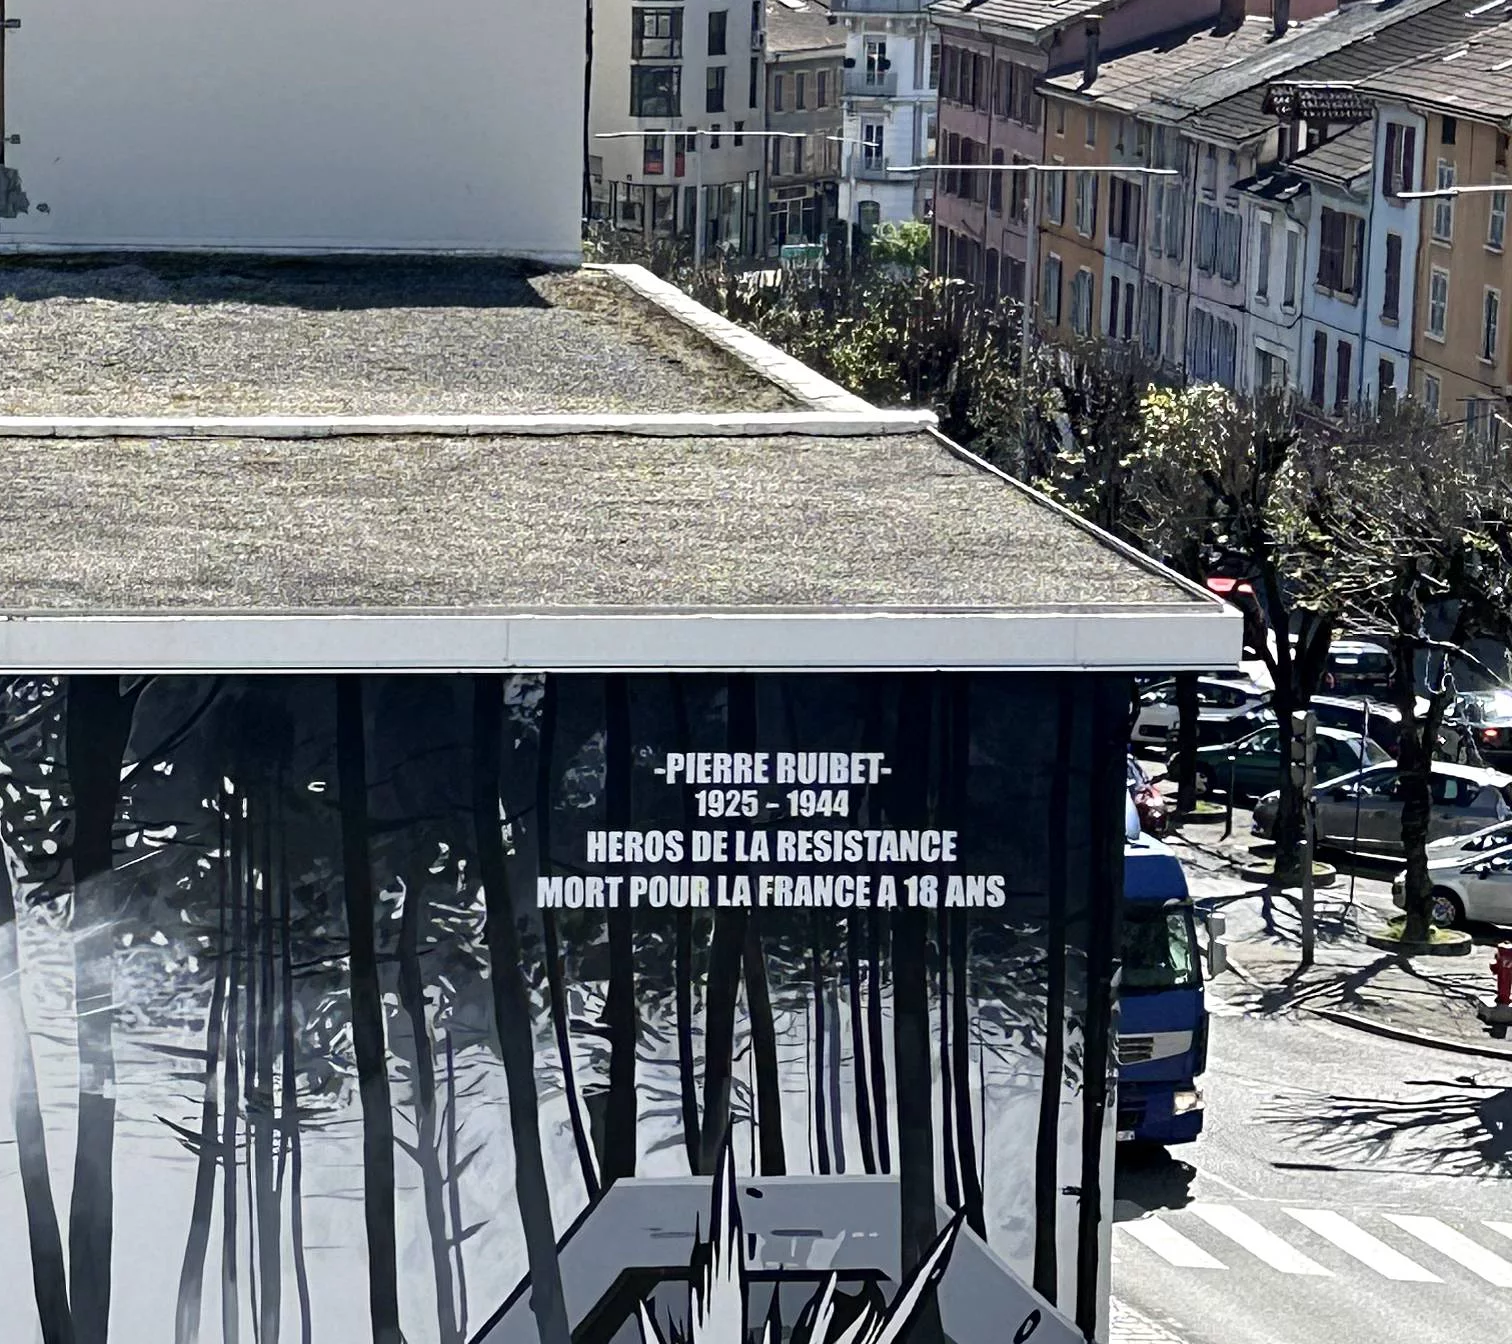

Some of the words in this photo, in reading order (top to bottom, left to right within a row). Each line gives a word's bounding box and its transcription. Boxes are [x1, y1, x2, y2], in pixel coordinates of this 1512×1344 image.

[654, 752, 770, 785] -PIERRE
[776, 752, 892, 785] RUIBET-
[694, 789, 759, 818] 1925
[786, 789, 849, 817] 1944
[586, 830, 684, 863] HEROS
[691, 830, 729, 862] DE
[735, 830, 770, 862] LA
[776, 829, 958, 863] RESISTANCE
[536, 875, 624, 909] MORT
[629, 875, 710, 908] POUR
[717, 875, 753, 907] LA
[758, 875, 871, 908] FRANCE
[876, 875, 898, 908] A
[903, 874, 939, 908] 18
[944, 875, 1006, 908] ANS
